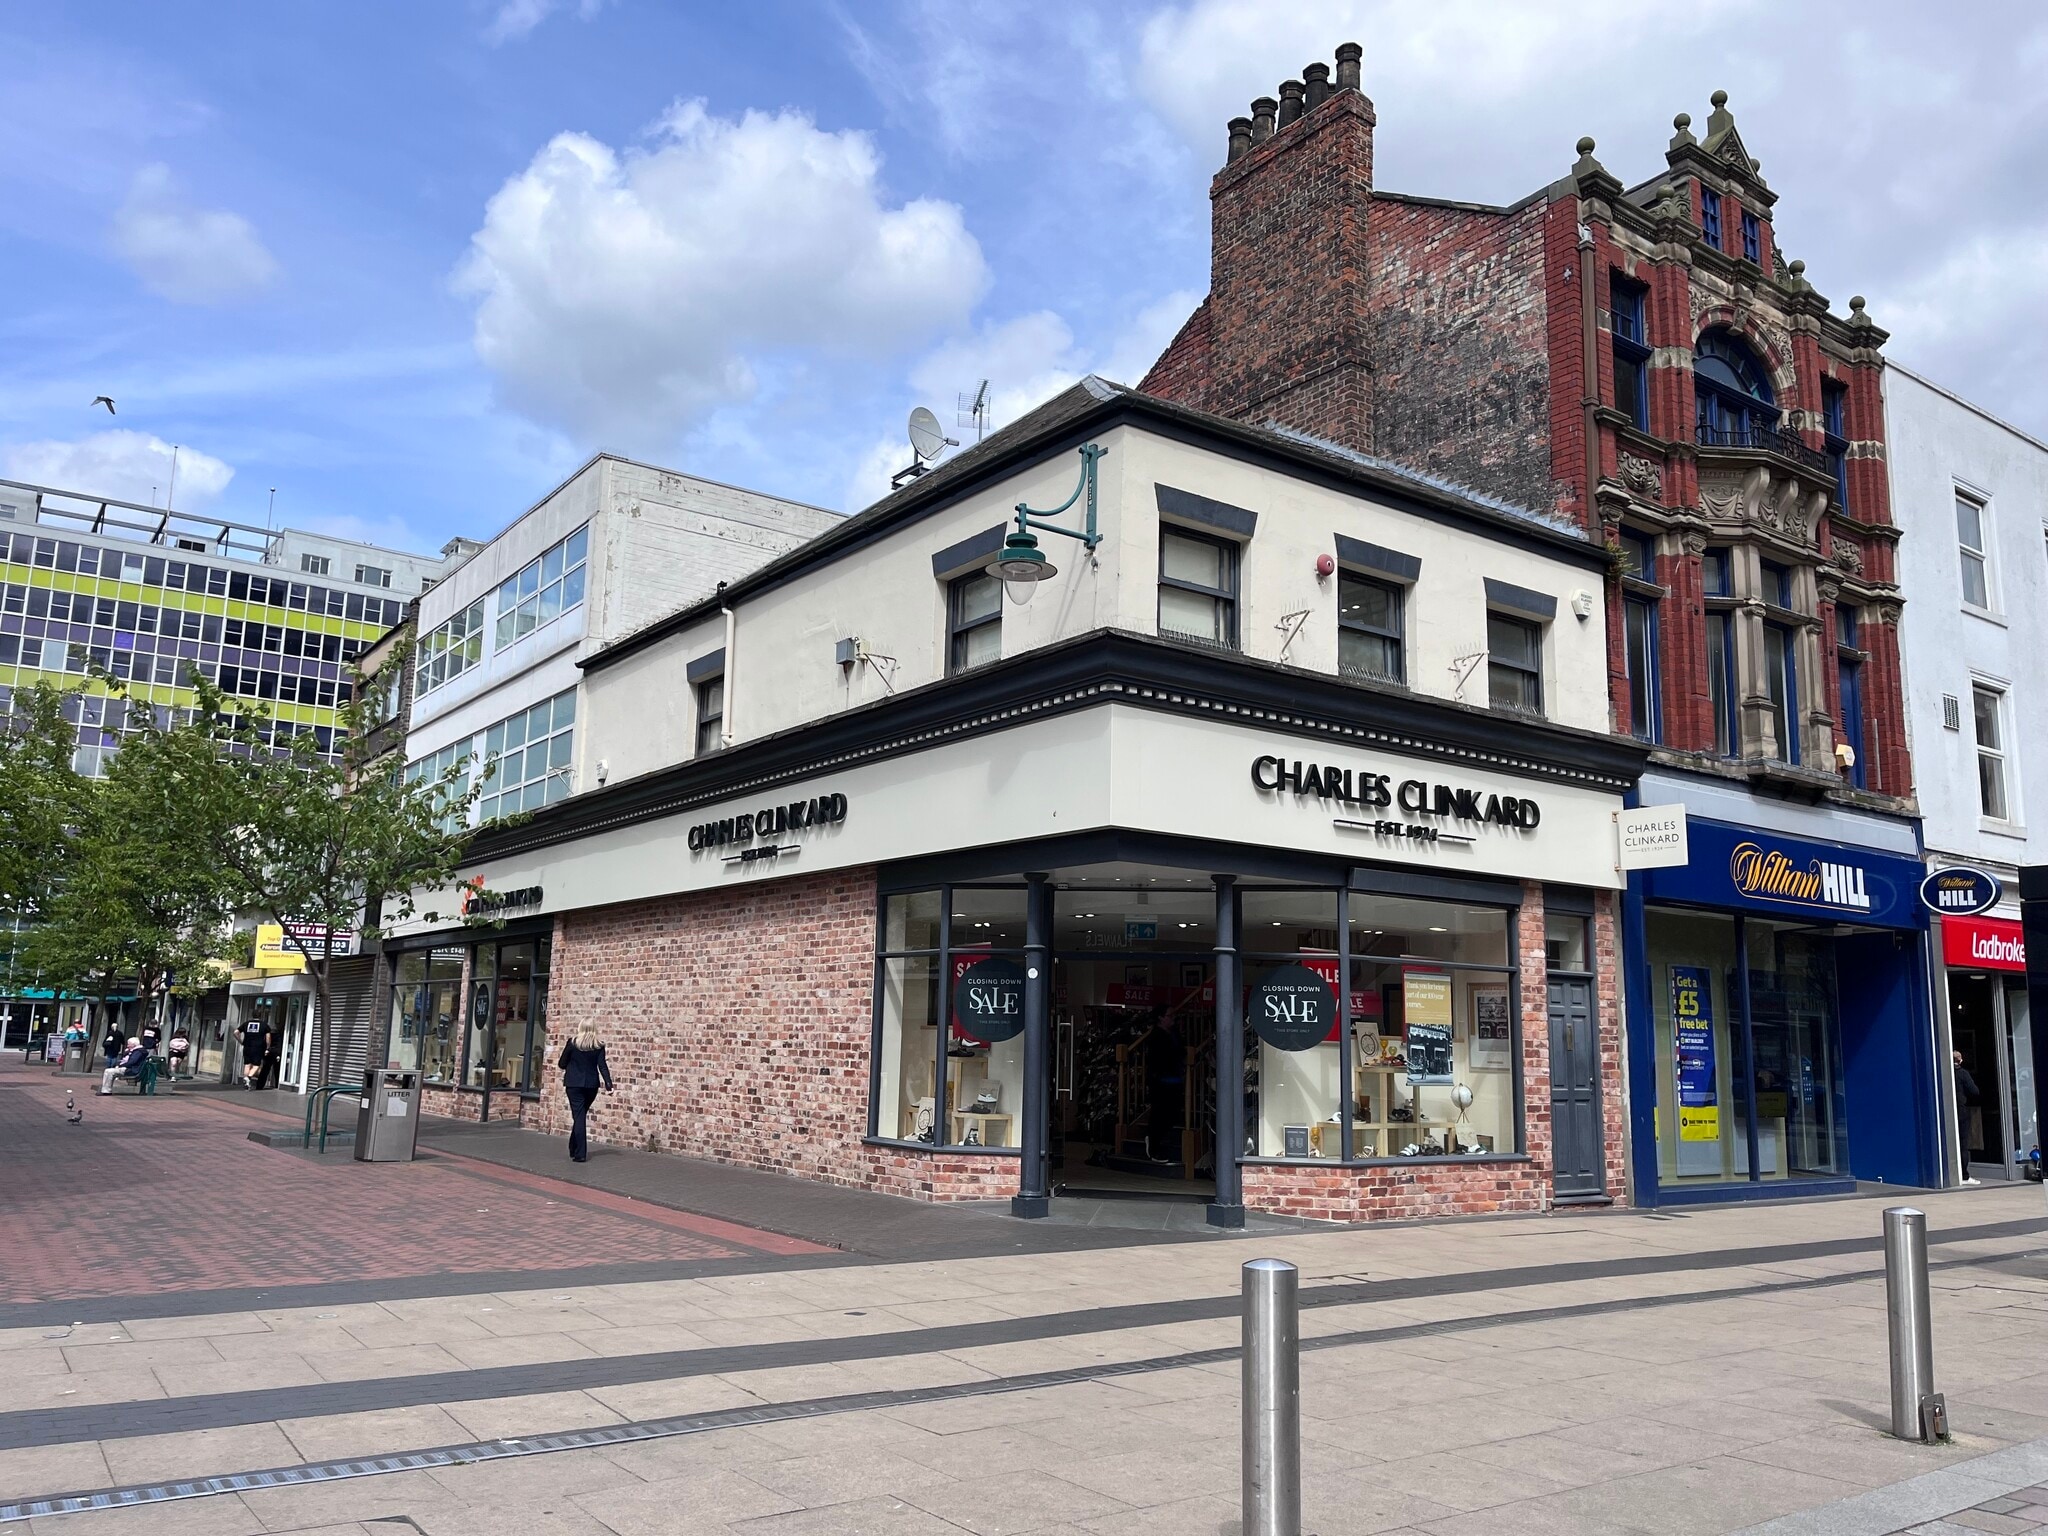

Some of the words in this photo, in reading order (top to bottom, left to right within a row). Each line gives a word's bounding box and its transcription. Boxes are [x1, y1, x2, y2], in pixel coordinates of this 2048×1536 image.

[1251, 754, 1391, 808] CHARLES
[1397, 779, 1541, 829] CLINKARD
[687, 813, 755, 851] CHARLES
[755, 792, 848, 837] CLINKARD
[1627, 820, 1676, 834] CHARLES
[1624, 833, 1680, 847] CLINKARD
[1730, 842, 1824, 901] William
[1821, 861, 1871, 908] HILL
[1937, 876, 1976, 889] William
[1938, 889, 1977, 907] HILL
[296, 926, 311, 934] LET
[1676, 976, 1692, 988] Get
[1692, 979, 1698, 988] a
[969, 987, 1018, 1015] SALE
[1125, 989, 1151, 1001] SALE
[1679, 990, 1700, 1016] £5
[1265, 994, 1318, 1023] SALE
[1679, 1017, 1695, 1029] free
[1695, 1018, 1709, 1030] bet
